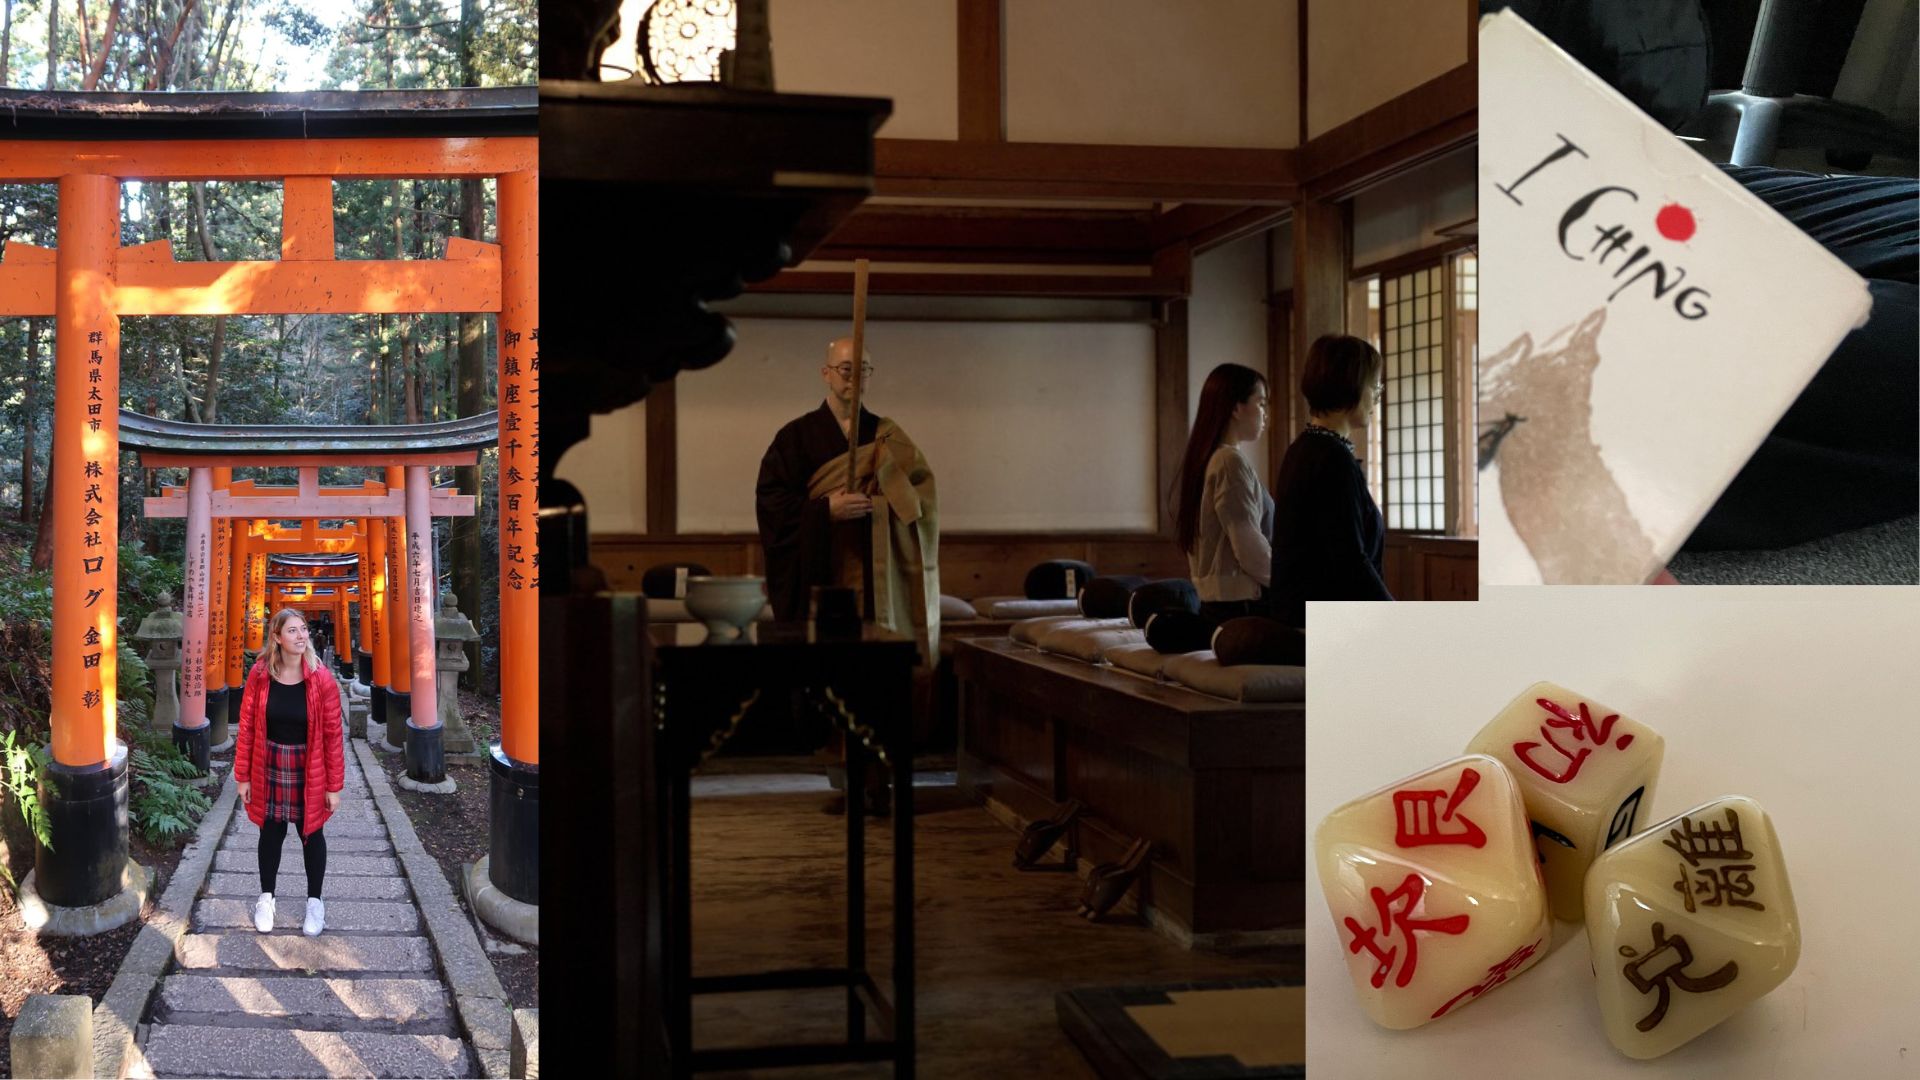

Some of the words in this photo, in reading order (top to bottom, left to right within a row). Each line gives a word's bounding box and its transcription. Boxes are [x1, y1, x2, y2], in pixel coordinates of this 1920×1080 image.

[1494, 133, 1589, 206] I
[1557, 184, 1711, 321] CHING
[88, 331, 103, 433] 群馬県太田市
[1513, 698, 1635, 783] 初
[1392, 768, 1487, 849] 艮
[1344, 873, 1470, 989] 坎
